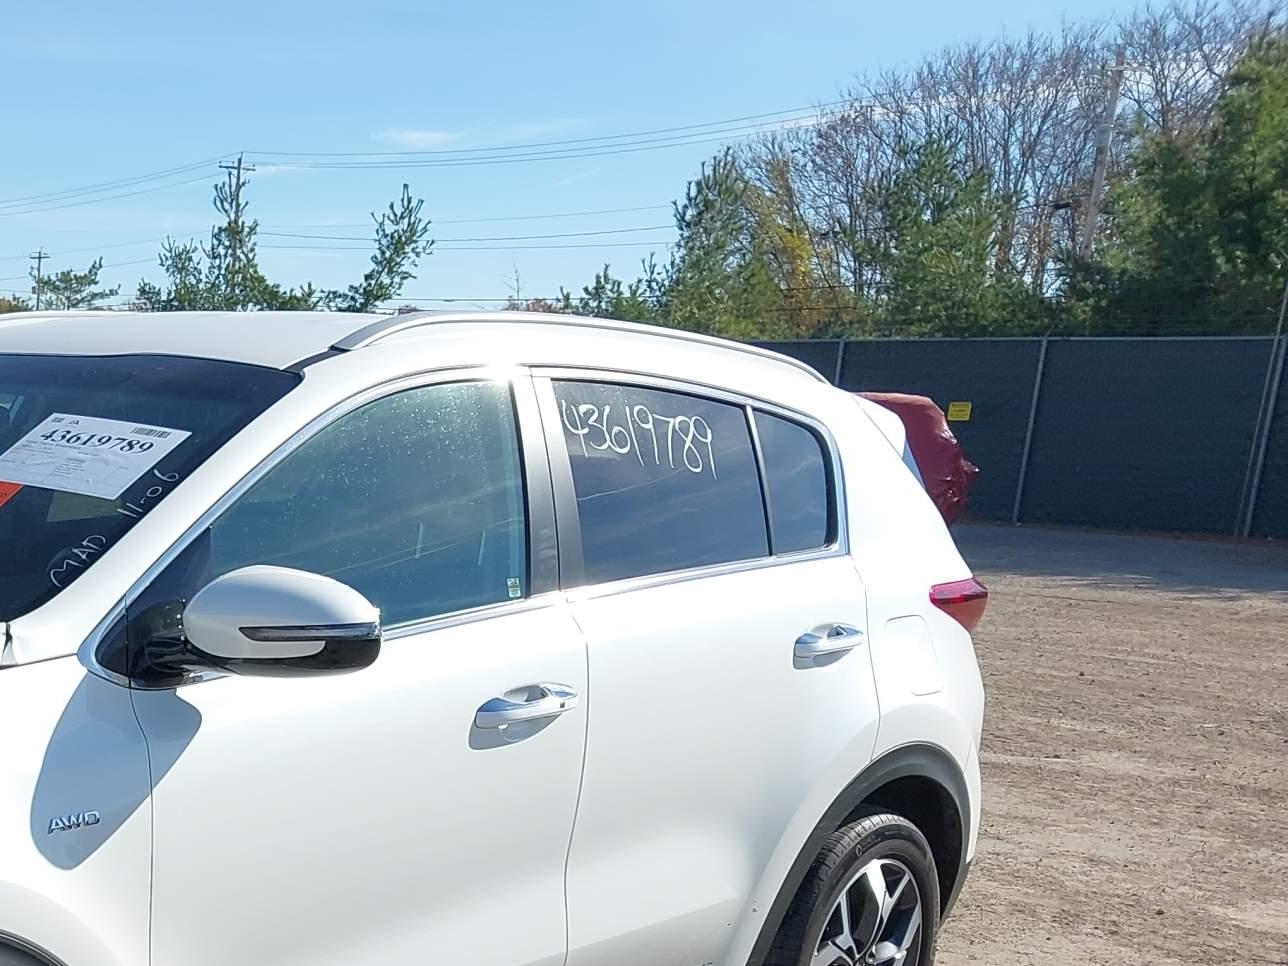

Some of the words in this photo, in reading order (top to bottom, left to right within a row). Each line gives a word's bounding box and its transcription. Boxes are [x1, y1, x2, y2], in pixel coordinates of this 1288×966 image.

[40, 428, 155, 454] 43619789
[561, 400, 718, 480] 43619789
[49, 534, 107, 587] MAD
[117, 469, 180, 518] 11-06
[48, 810, 101, 834] AWD
